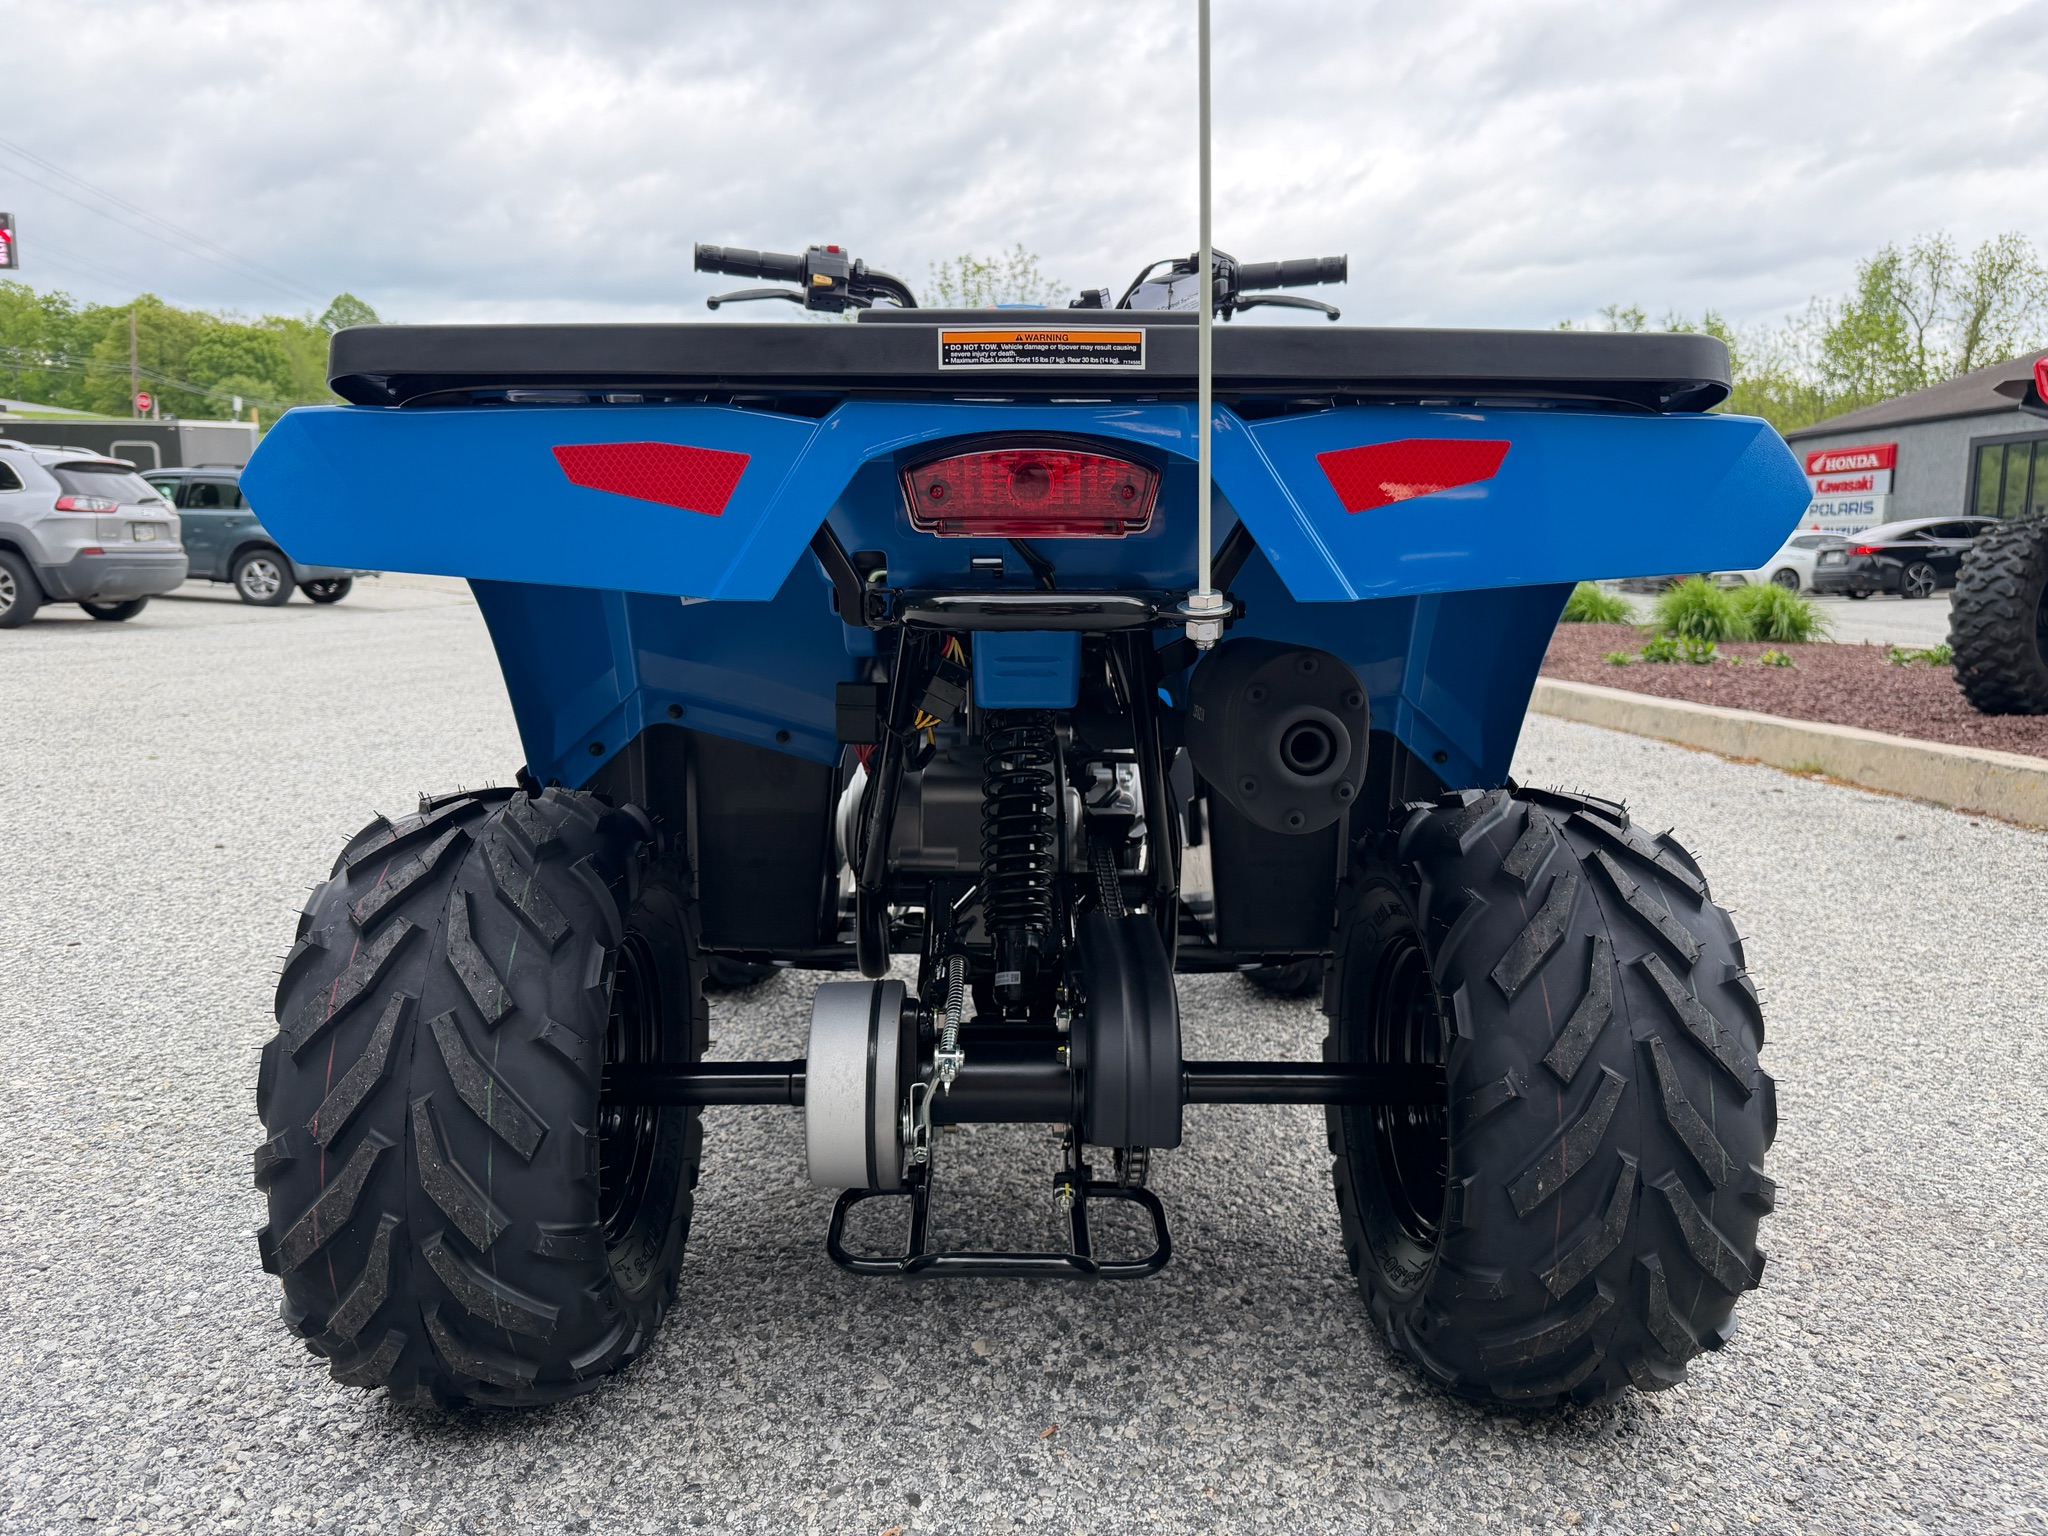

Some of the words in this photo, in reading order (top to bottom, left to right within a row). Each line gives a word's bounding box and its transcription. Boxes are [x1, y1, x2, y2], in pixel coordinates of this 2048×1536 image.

[1024, 334, 1069, 342] WARNING
[971, 350, 989, 358] injury
[1112, 344, 1137, 352] causing
[1825, 453, 1880, 472] HONDA
[1815, 474, 1875, 494] Kawasaki
[1808, 500, 1874, 517] POLARIS
